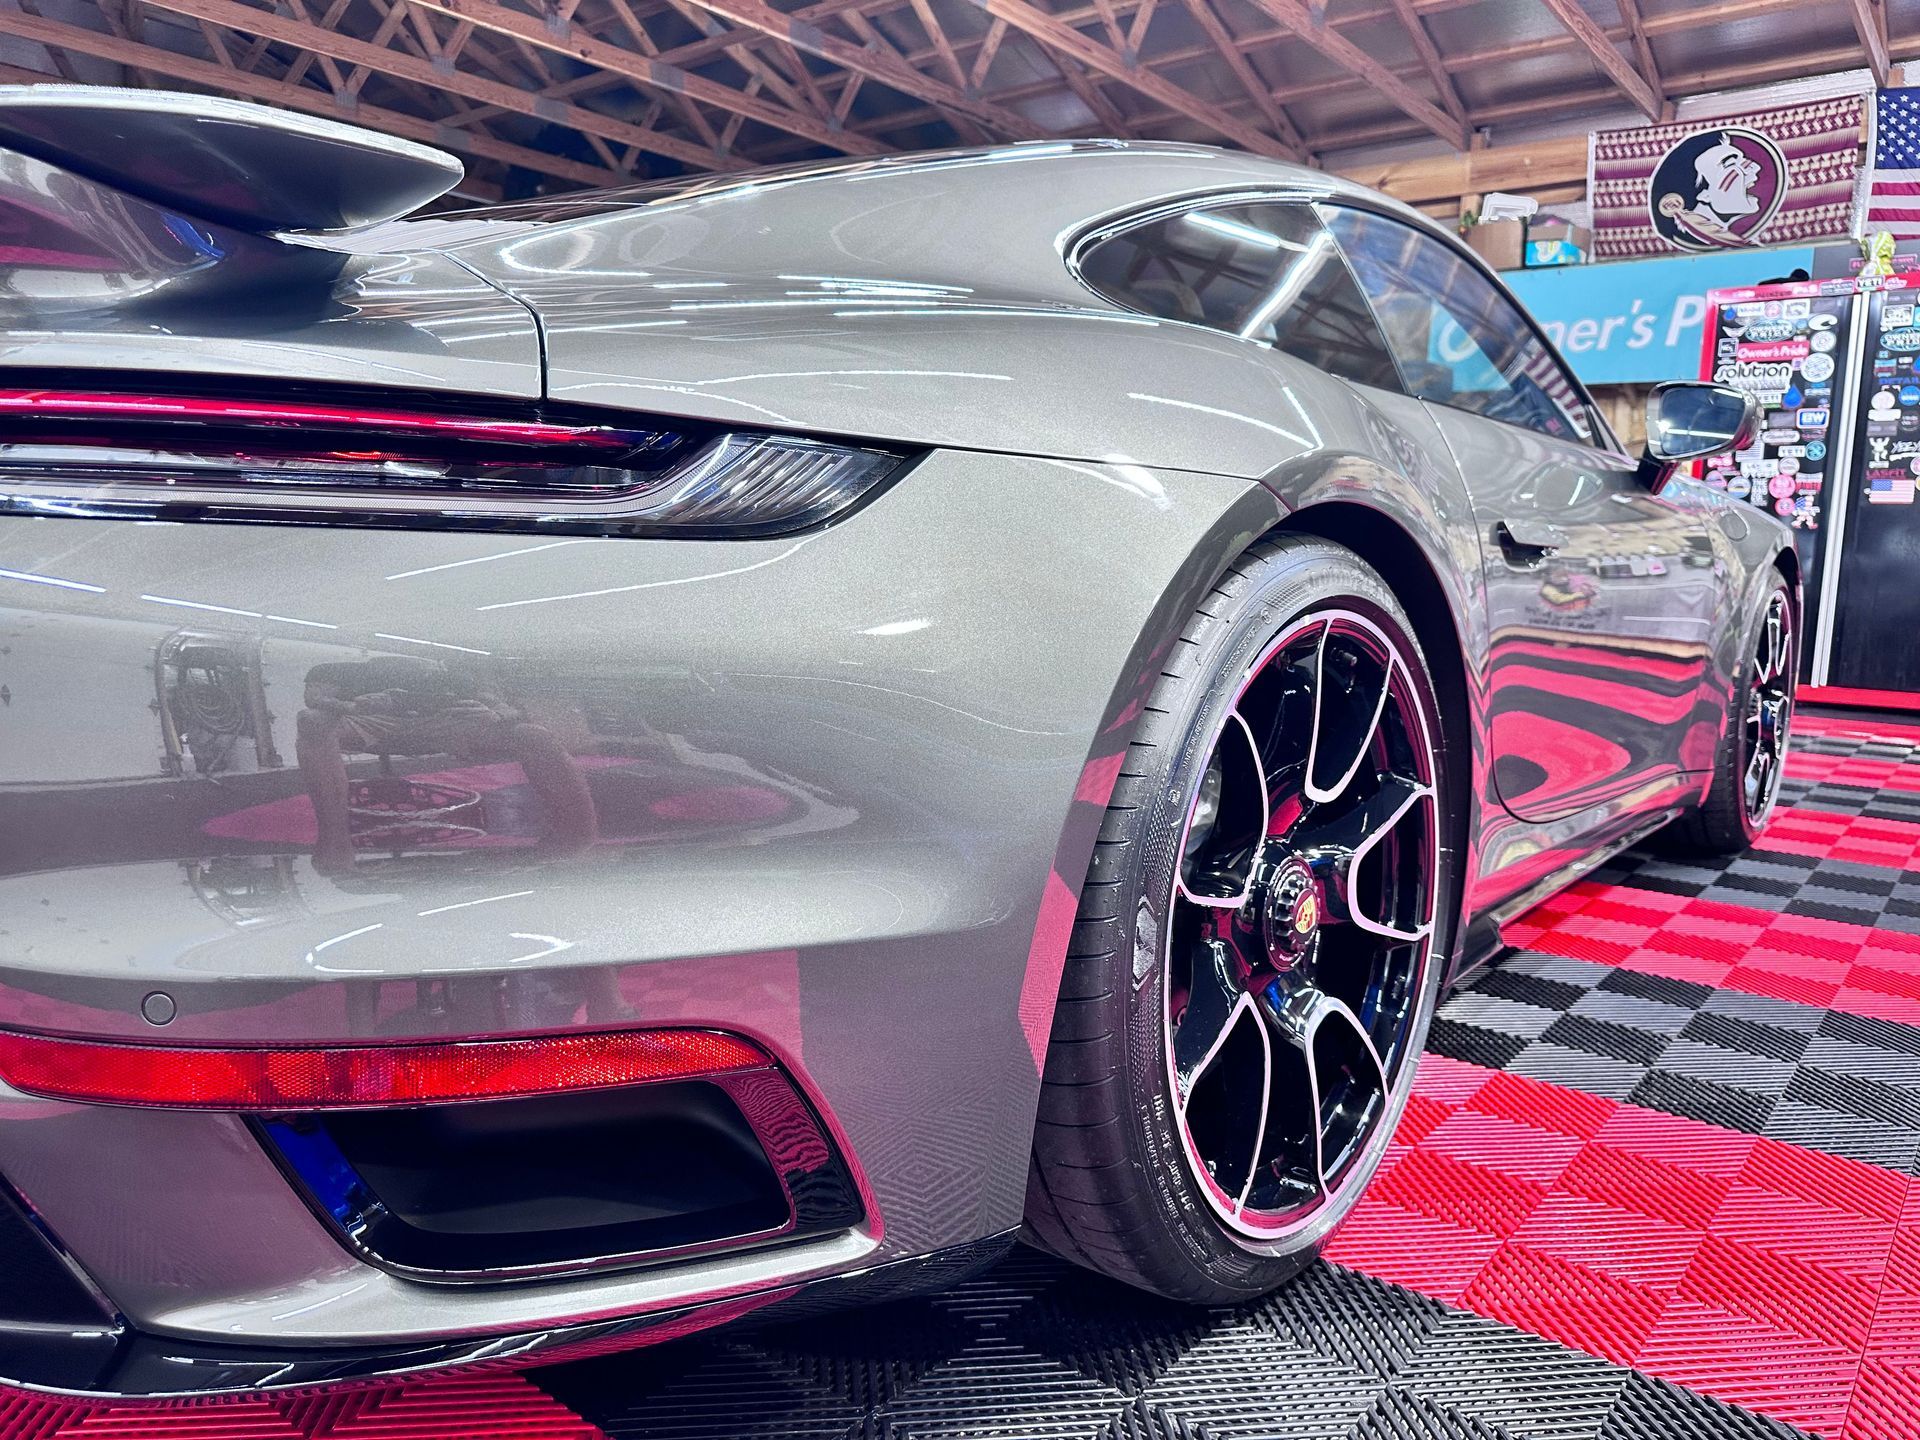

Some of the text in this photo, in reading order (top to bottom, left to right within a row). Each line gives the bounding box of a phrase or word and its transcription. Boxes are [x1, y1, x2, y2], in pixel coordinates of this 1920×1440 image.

[1664, 295, 1706, 347] P
[1738, 342, 1809, 359] Owner's Pride
[1717, 364, 1789, 379] solution
